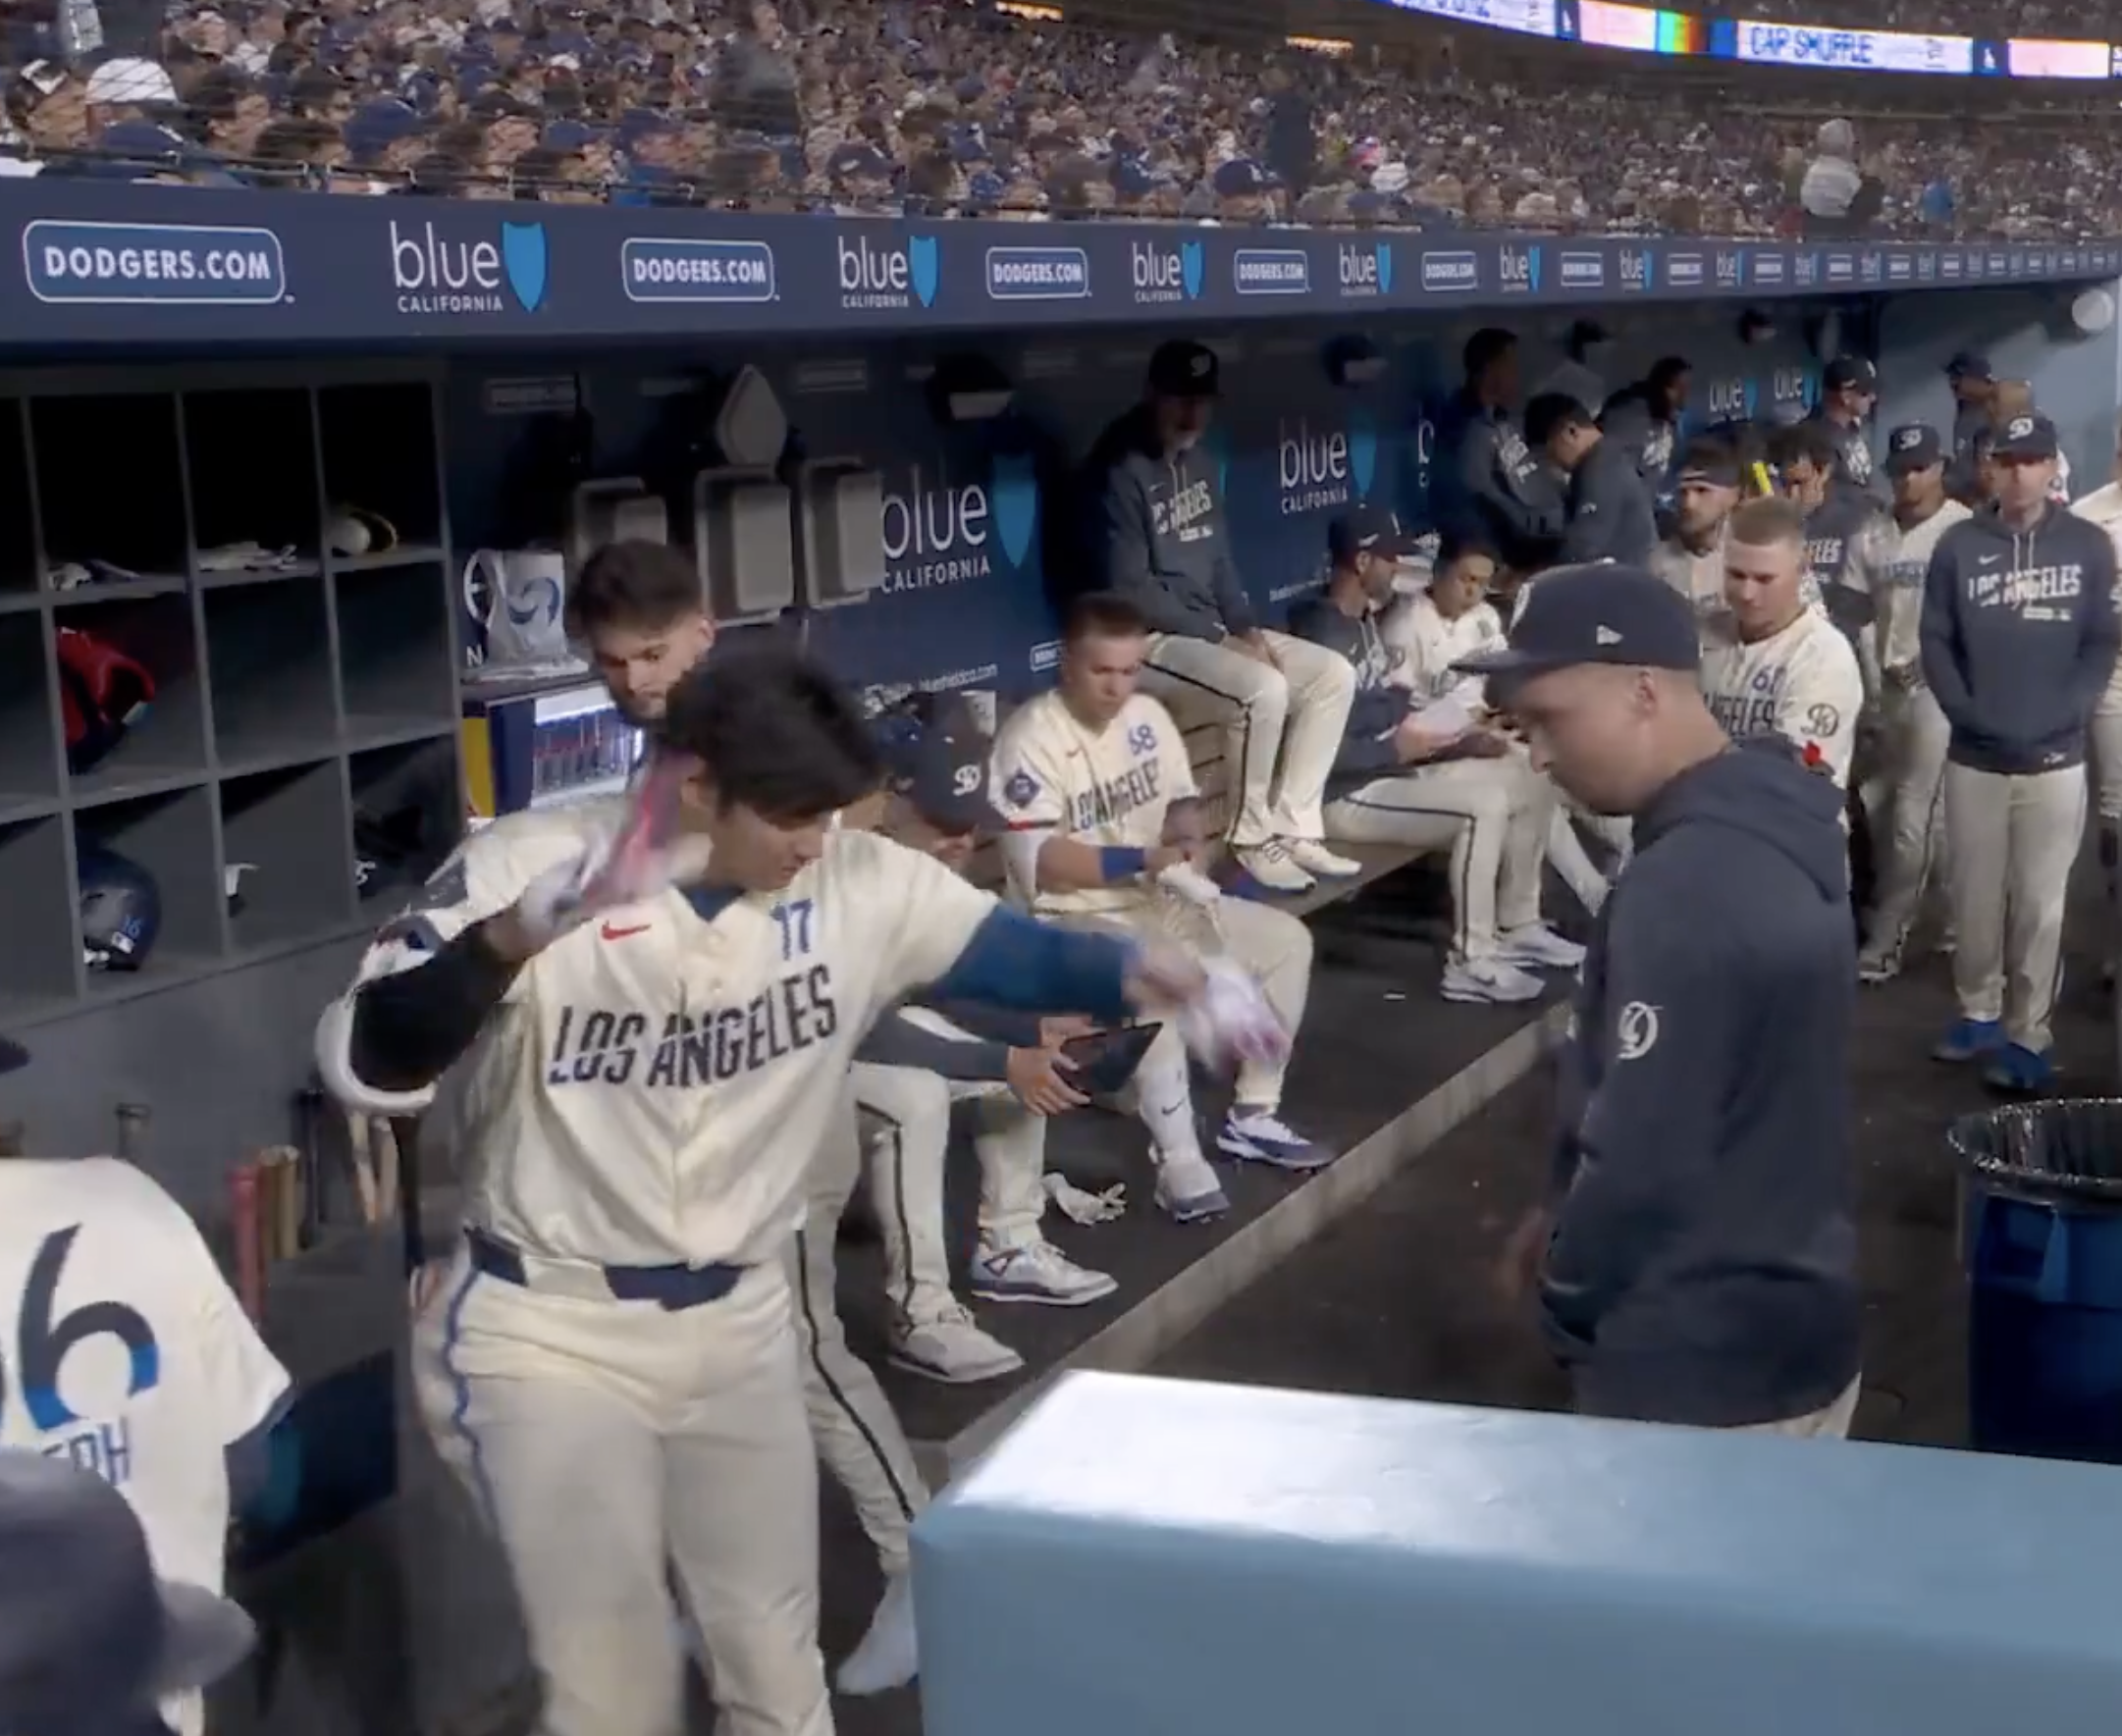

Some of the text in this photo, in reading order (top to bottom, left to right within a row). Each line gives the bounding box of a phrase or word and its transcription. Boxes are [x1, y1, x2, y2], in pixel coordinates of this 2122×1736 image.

[45, 245, 270, 281] DODGERS.COM
[391, 220, 500, 288] blue
[633, 259, 766, 285] DODGERS.COM
[838, 237, 908, 289] blue
[1133, 242, 1182, 286] blue
[1240, 263, 1304, 280] DODGERS.COM
[1340, 244, 1376, 283] blue
[1500, 244, 1528, 280] blue
[1619, 249, 1643, 280] blue
[993, 262, 1082, 285] DODGERS.COM
[398, 295, 503, 312] CALIFORNIA
[842, 295, 909, 308] CALIFORNIA
[1135, 291, 1182, 302] CALIFORNIA
[1280, 417, 1347, 490] blue
[1282, 488, 1348, 513] CALIFORNIA
[770, 898, 814, 961] 17
[549, 963, 837, 1088] LOS ANGELES
